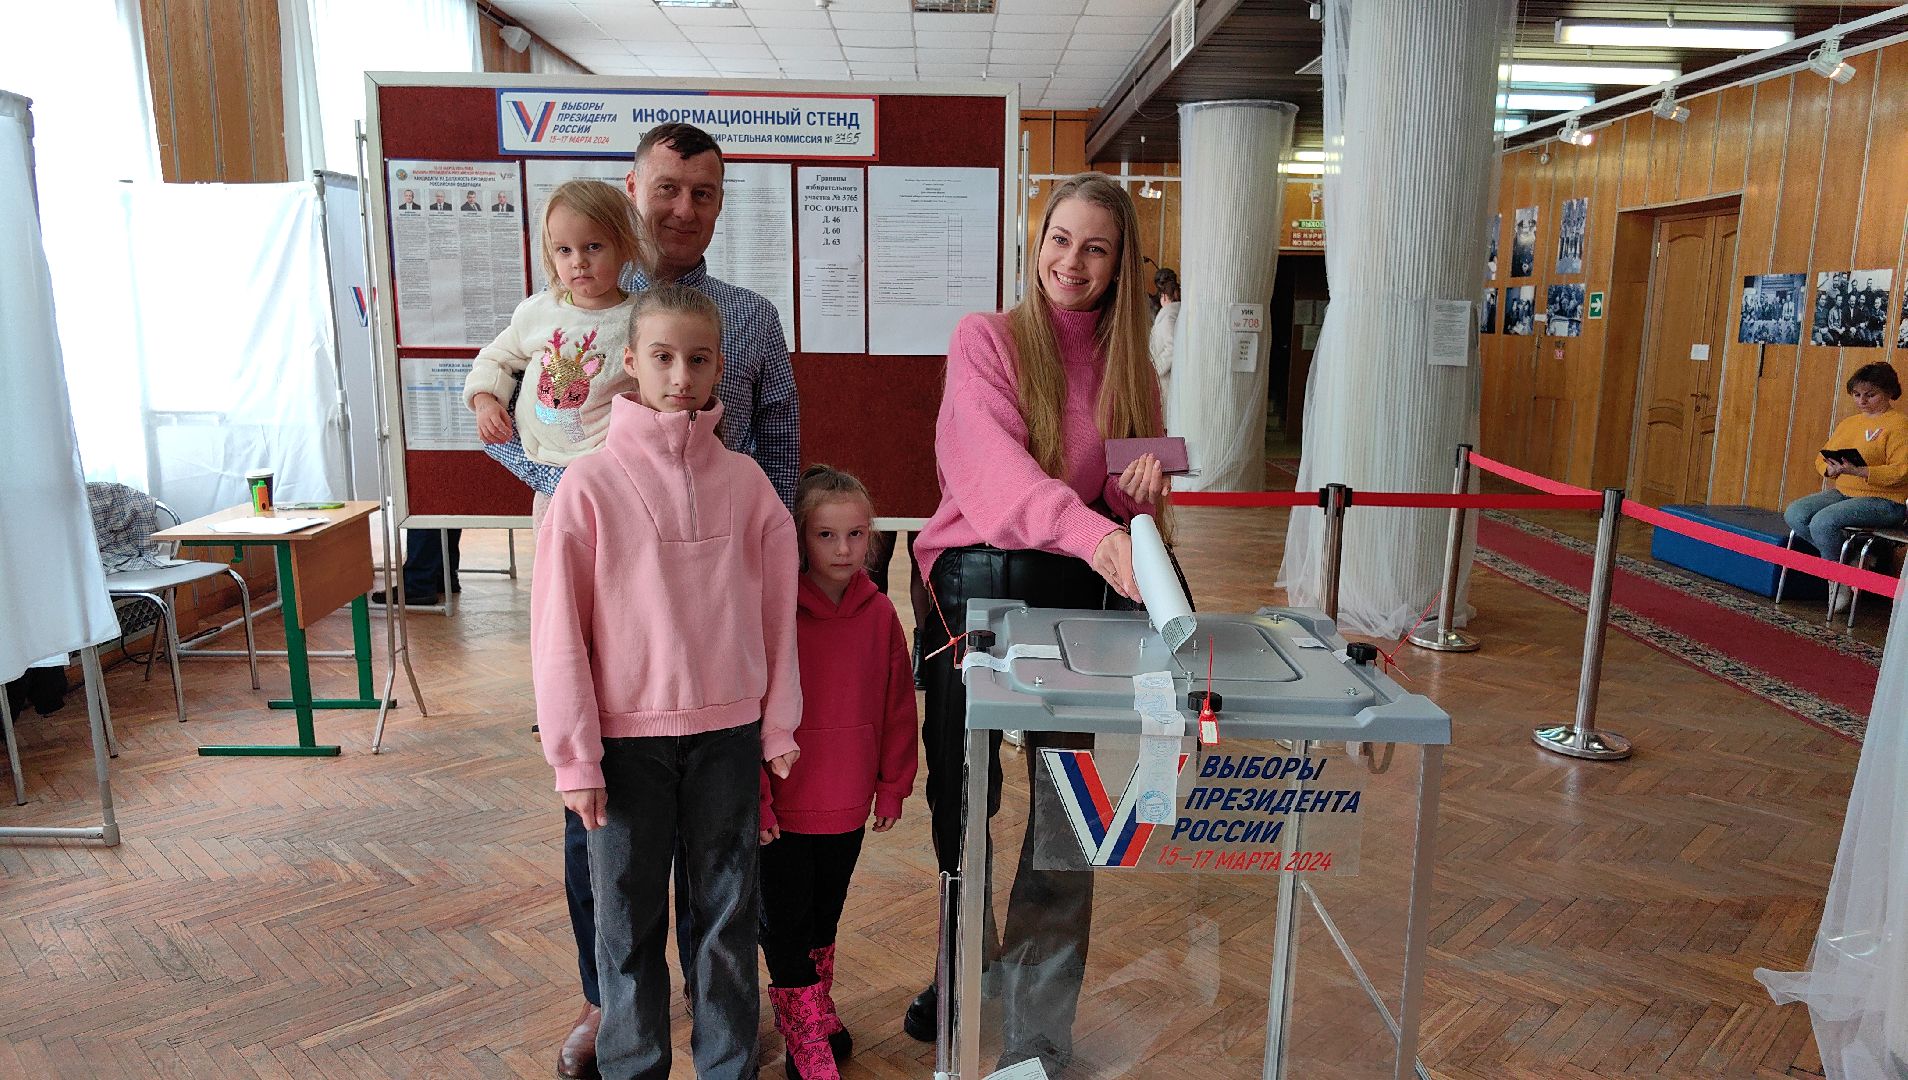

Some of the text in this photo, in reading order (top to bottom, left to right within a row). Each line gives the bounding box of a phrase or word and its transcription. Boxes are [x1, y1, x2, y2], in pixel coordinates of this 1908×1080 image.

[561, 101, 605, 111] ВЫБОРЫ
[557, 113, 618, 123] ПРЕЗИДЕНТА
[632, 107, 860, 130] ИНФОРМАЦИОННЫЙ СТЕНД
[552, 124, 591, 134] РОССИИ
[568, 135, 592, 144] МАРТА
[593, 135, 610, 144] 2024
[711, 133, 772, 143] БИРАТЕЛЬНАЯ
[774, 134, 822, 144] КОМИССИЯ
[824, 135, 833, 144] №
[816, 174, 847, 182] Границы
[805, 184, 858, 192] избирательного
[824, 205, 859, 213] ОРБИТА
[832, 227, 841, 235] 60
[832, 238, 841, 246] 63
[1243, 318, 1260, 329] 708
[1199, 755, 1327, 781] ВЫБОРЫ
[1184, 787, 1361, 816] ПРЕЗИДЕНТА
[1171, 817, 1285, 844] РОССИИ
[1215, 850, 1282, 872] МАРТА
[1284, 851, 1333, 872] 2024
